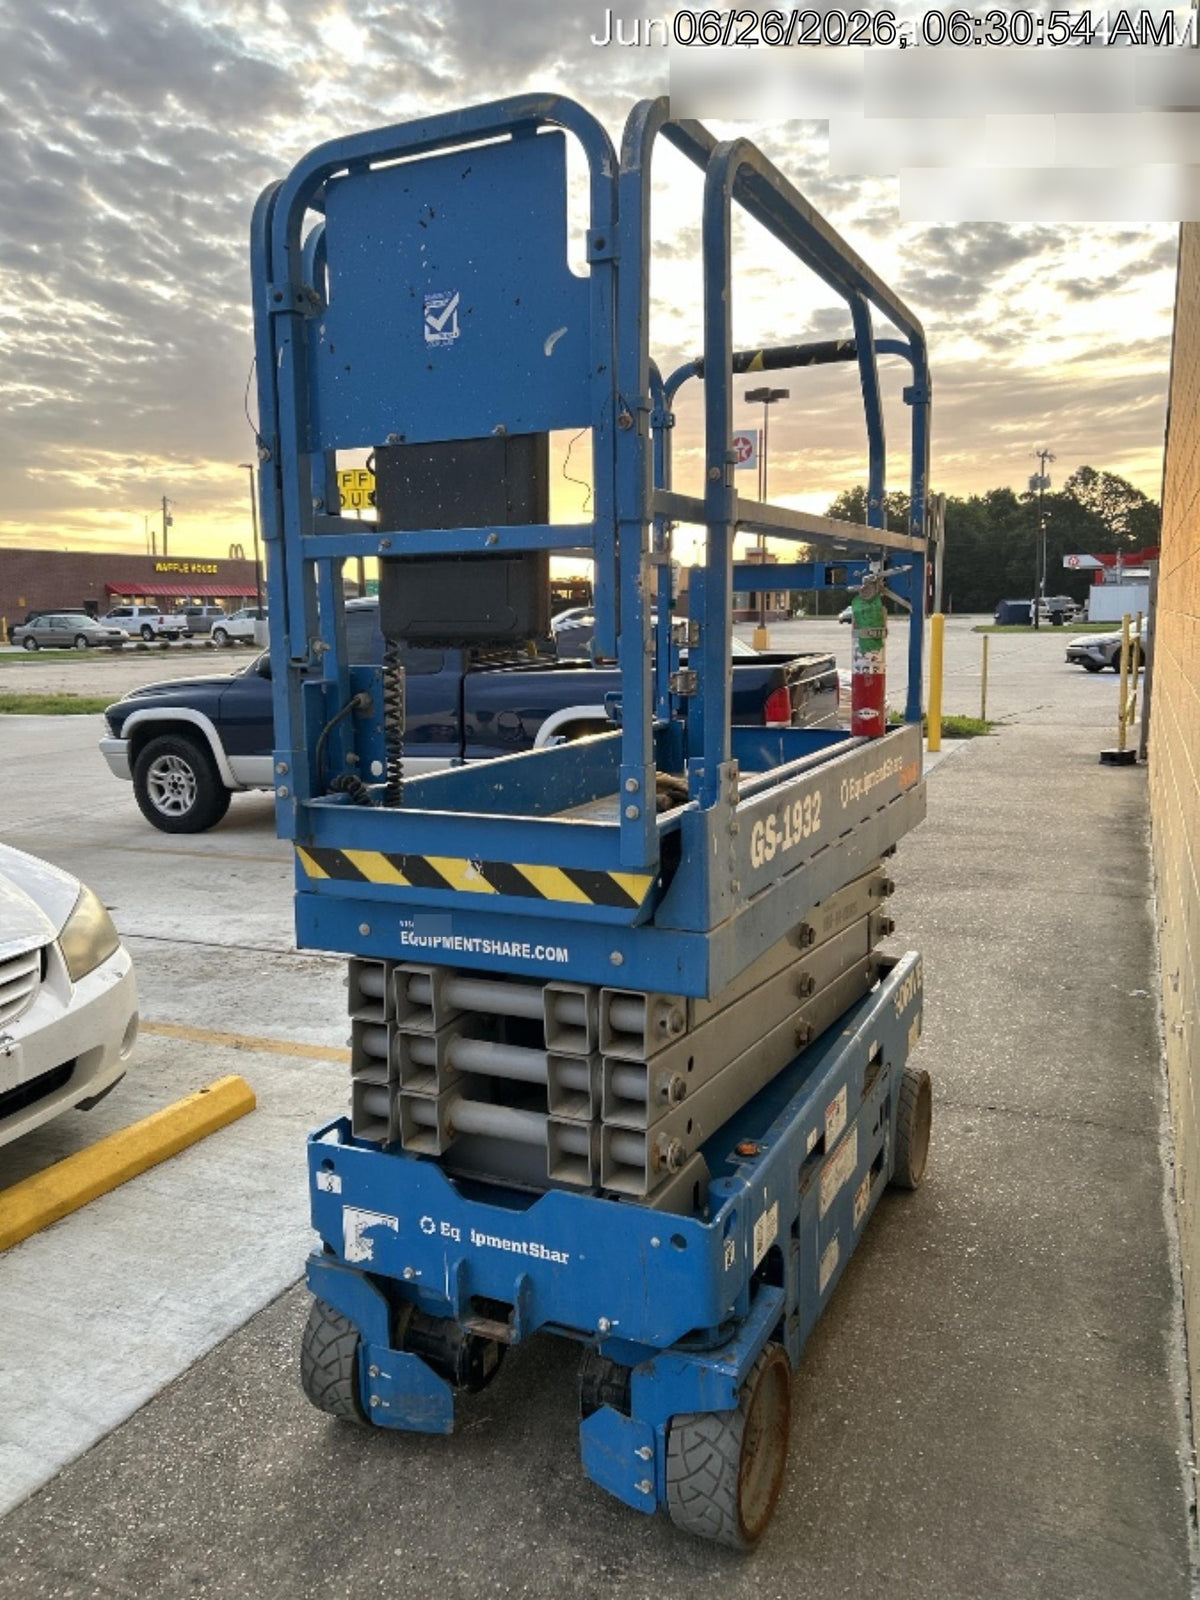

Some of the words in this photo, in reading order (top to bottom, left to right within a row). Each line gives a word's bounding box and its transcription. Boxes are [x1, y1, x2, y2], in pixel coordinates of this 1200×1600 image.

[155, 562, 189, 574] WAFFLE
[191, 563, 218, 574] HOUSE
[750, 789, 823, 869] GS-1932
[400, 930, 569, 963] EQUIPMENTSHARE.COM
